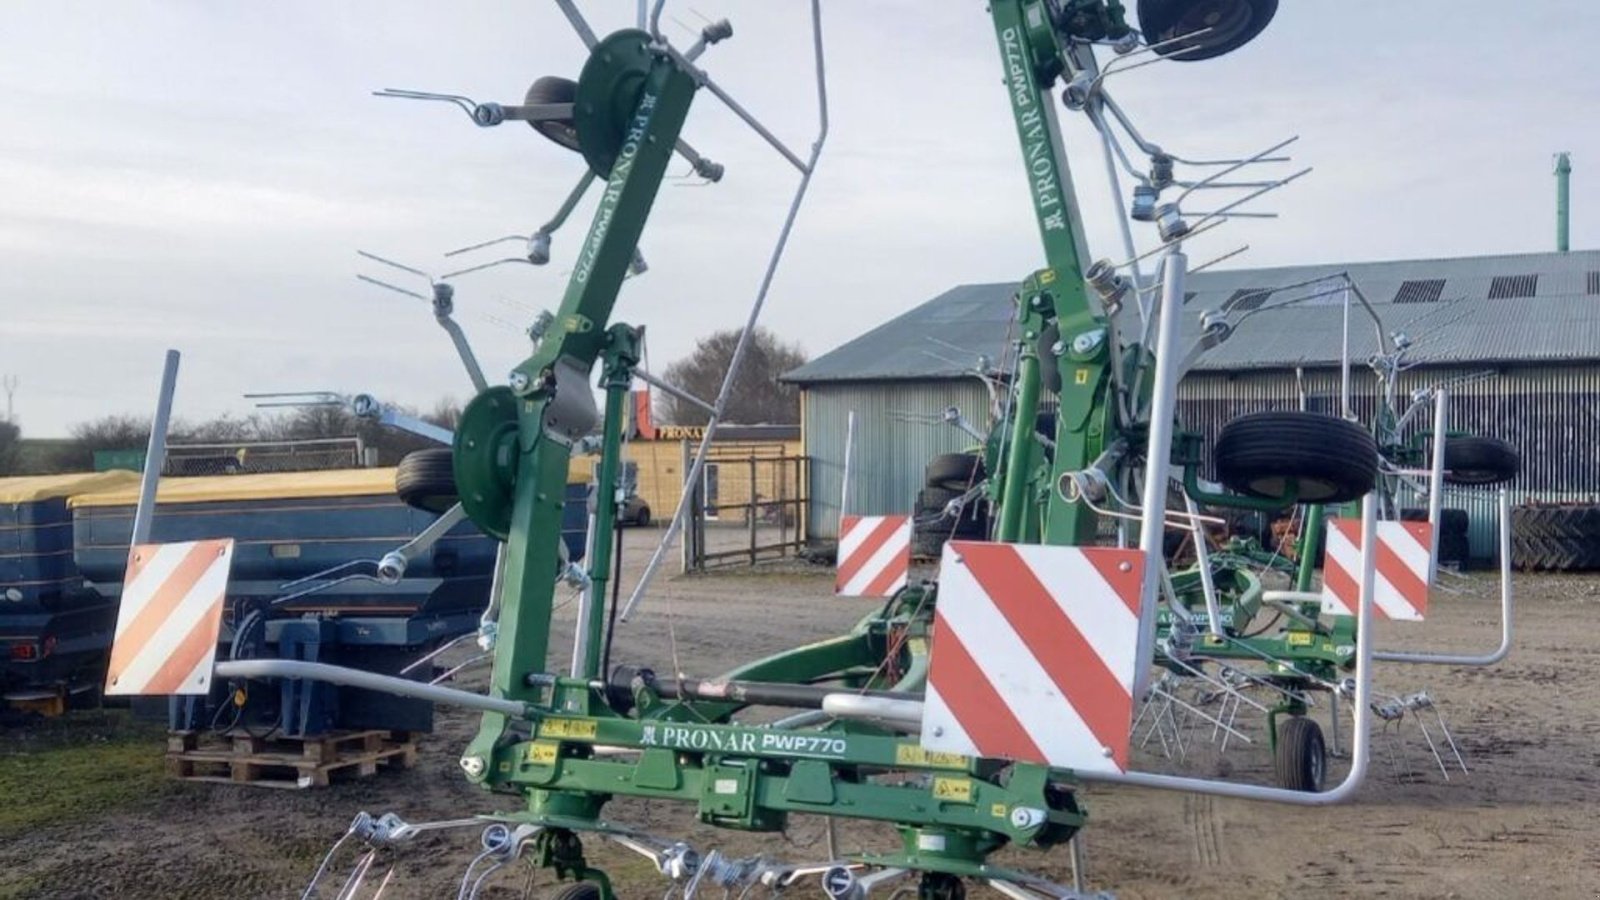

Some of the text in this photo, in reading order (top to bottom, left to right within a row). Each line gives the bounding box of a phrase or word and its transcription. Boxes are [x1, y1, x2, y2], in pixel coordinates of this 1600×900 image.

[576, 115, 649, 283] PRONAR PWP770
[1002, 27, 1059, 209] PRONAR PWP770
[663, 727, 846, 754] PRONAR PWP770
